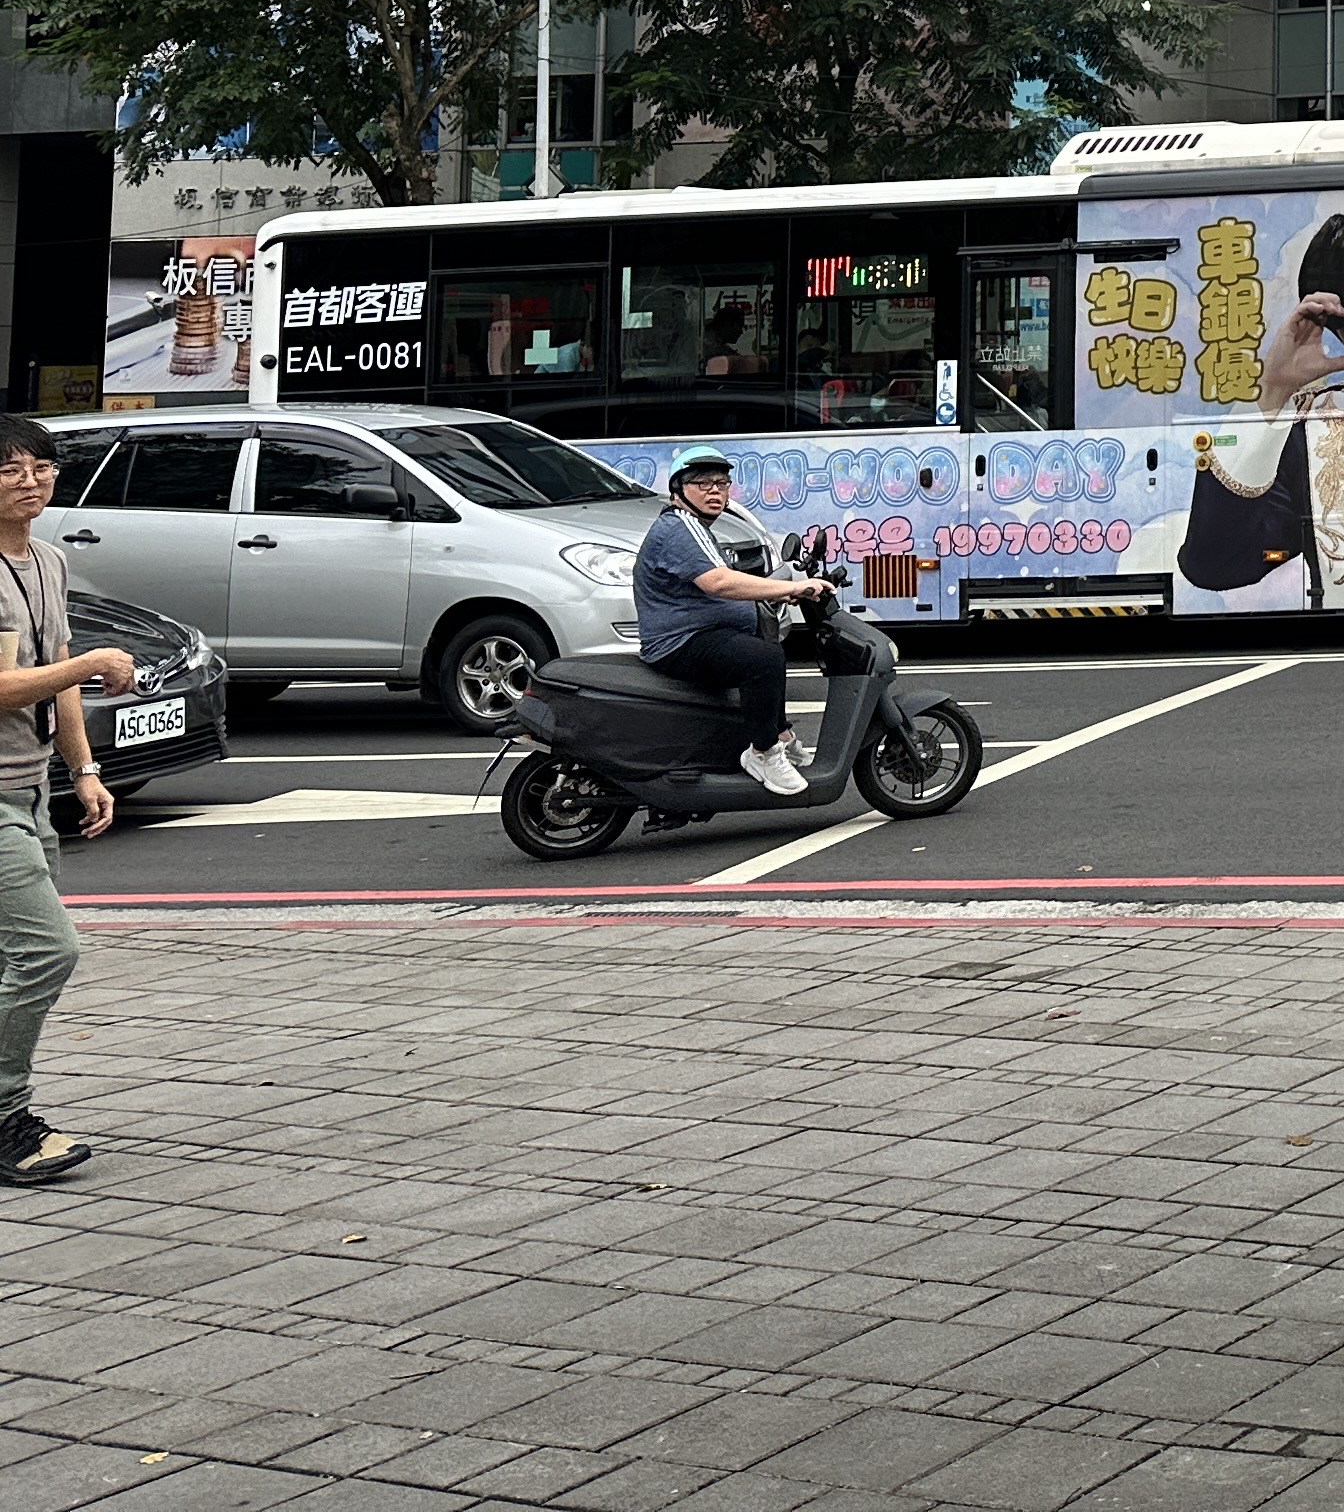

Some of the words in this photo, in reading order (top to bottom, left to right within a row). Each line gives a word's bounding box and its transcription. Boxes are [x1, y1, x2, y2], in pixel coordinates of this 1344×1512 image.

[162, 257, 255, 296] 板信
[1084, 266, 1177, 332] 生日
[283, 281, 427, 328] 首都客運
[1194, 216, 1266, 405] 車銀優
[286, 341, 422, 374] EAL-0081
[1088, 333, 1186, 394] 快樂
[723, 445, 960, 511] UN-WOO
[989, 438, 1126, 504] DAY
[933, 519, 1132, 557] 19970330
[118, 707, 184, 741] ASC-0365
